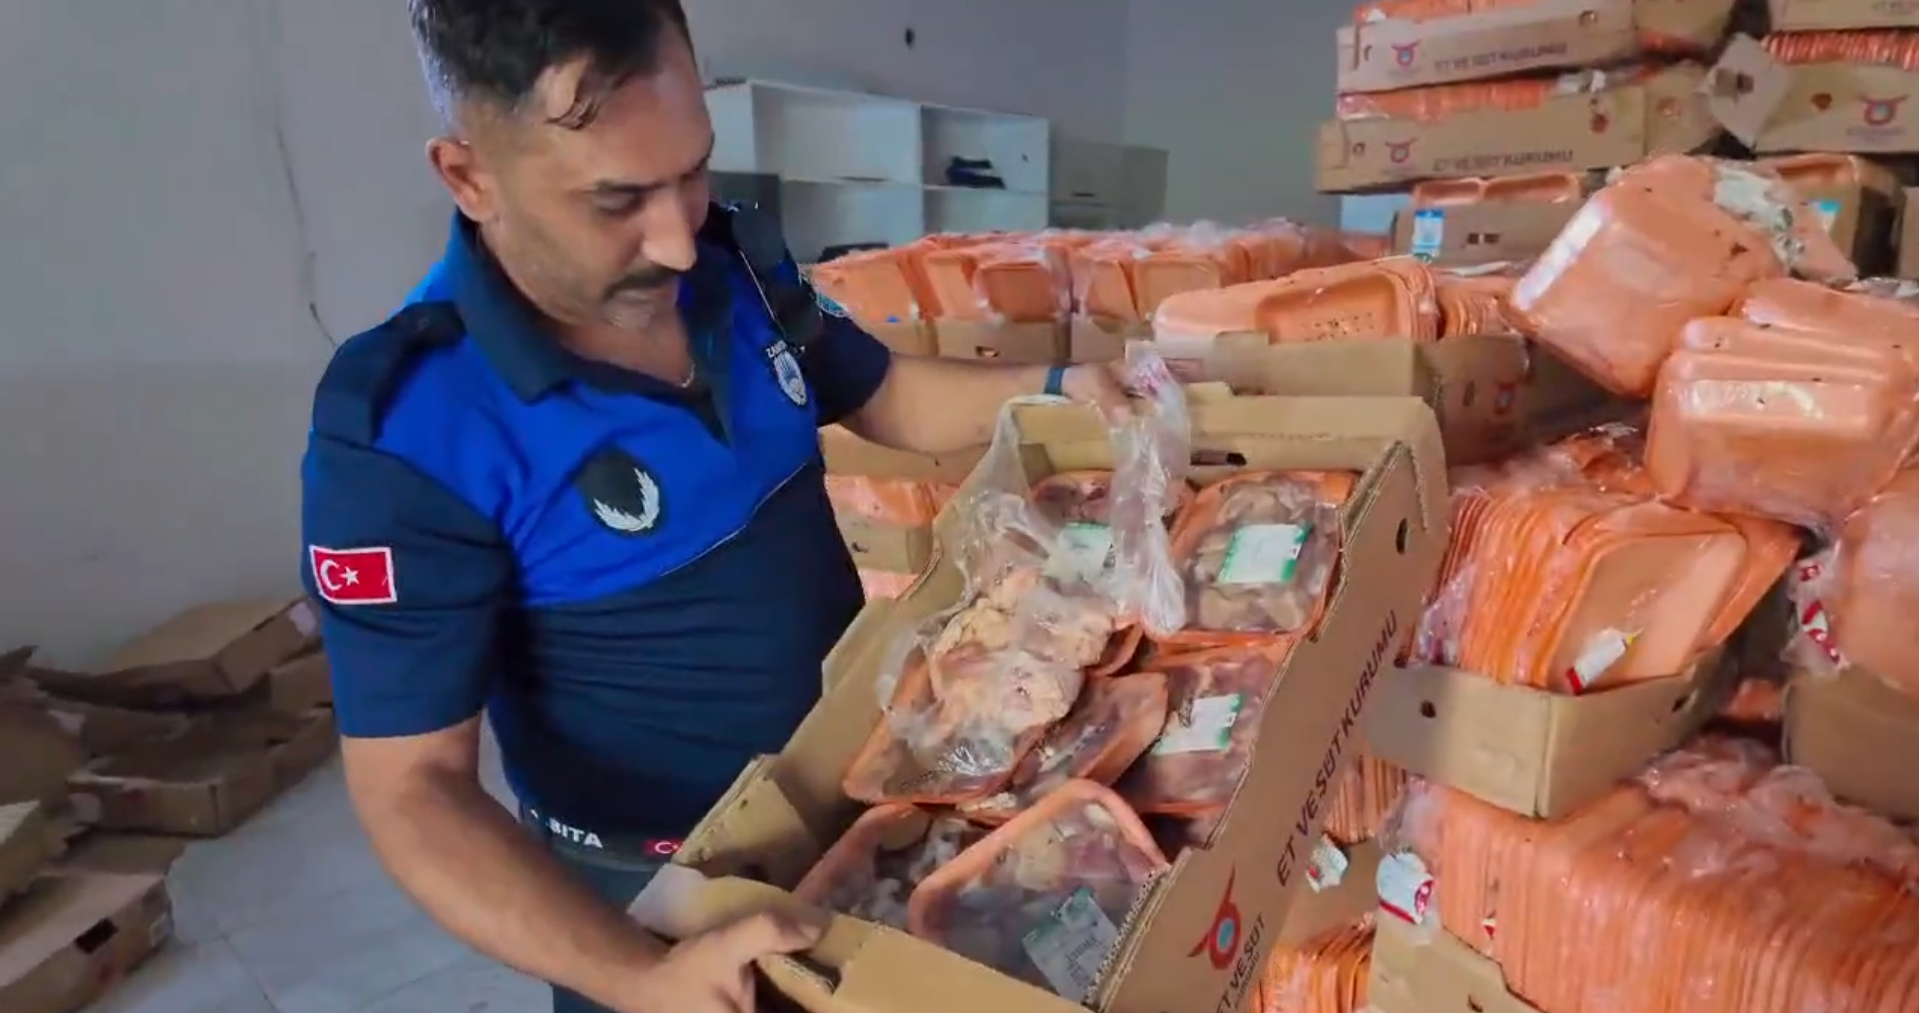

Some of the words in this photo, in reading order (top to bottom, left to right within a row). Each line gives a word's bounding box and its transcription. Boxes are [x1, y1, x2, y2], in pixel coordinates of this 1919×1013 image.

[1277, 834, 1296, 887] ET
[1296, 790, 1319, 836] VE
[1341, 608, 1397, 738] KURUMU
[1229, 956, 1247, 989] VE
